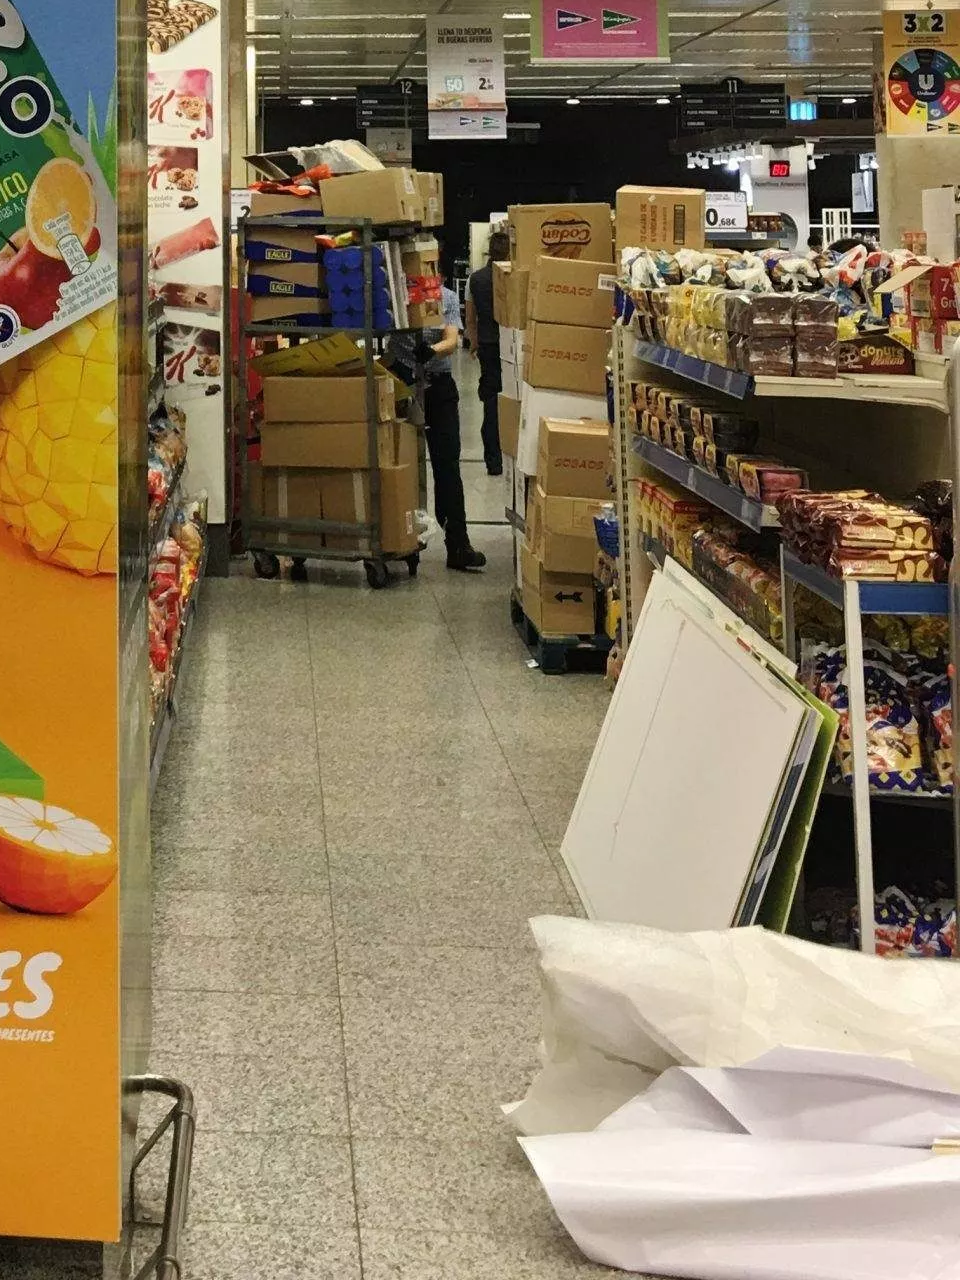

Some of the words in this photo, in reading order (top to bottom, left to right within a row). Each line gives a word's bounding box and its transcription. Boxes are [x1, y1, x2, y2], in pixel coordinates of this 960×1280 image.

[401, 81, 412, 94] 12
[546, 284, 593, 297] SOBAOS
[540, 349, 589, 362] SOBAOS
[554, 457, 604, 470] SOBAOS
